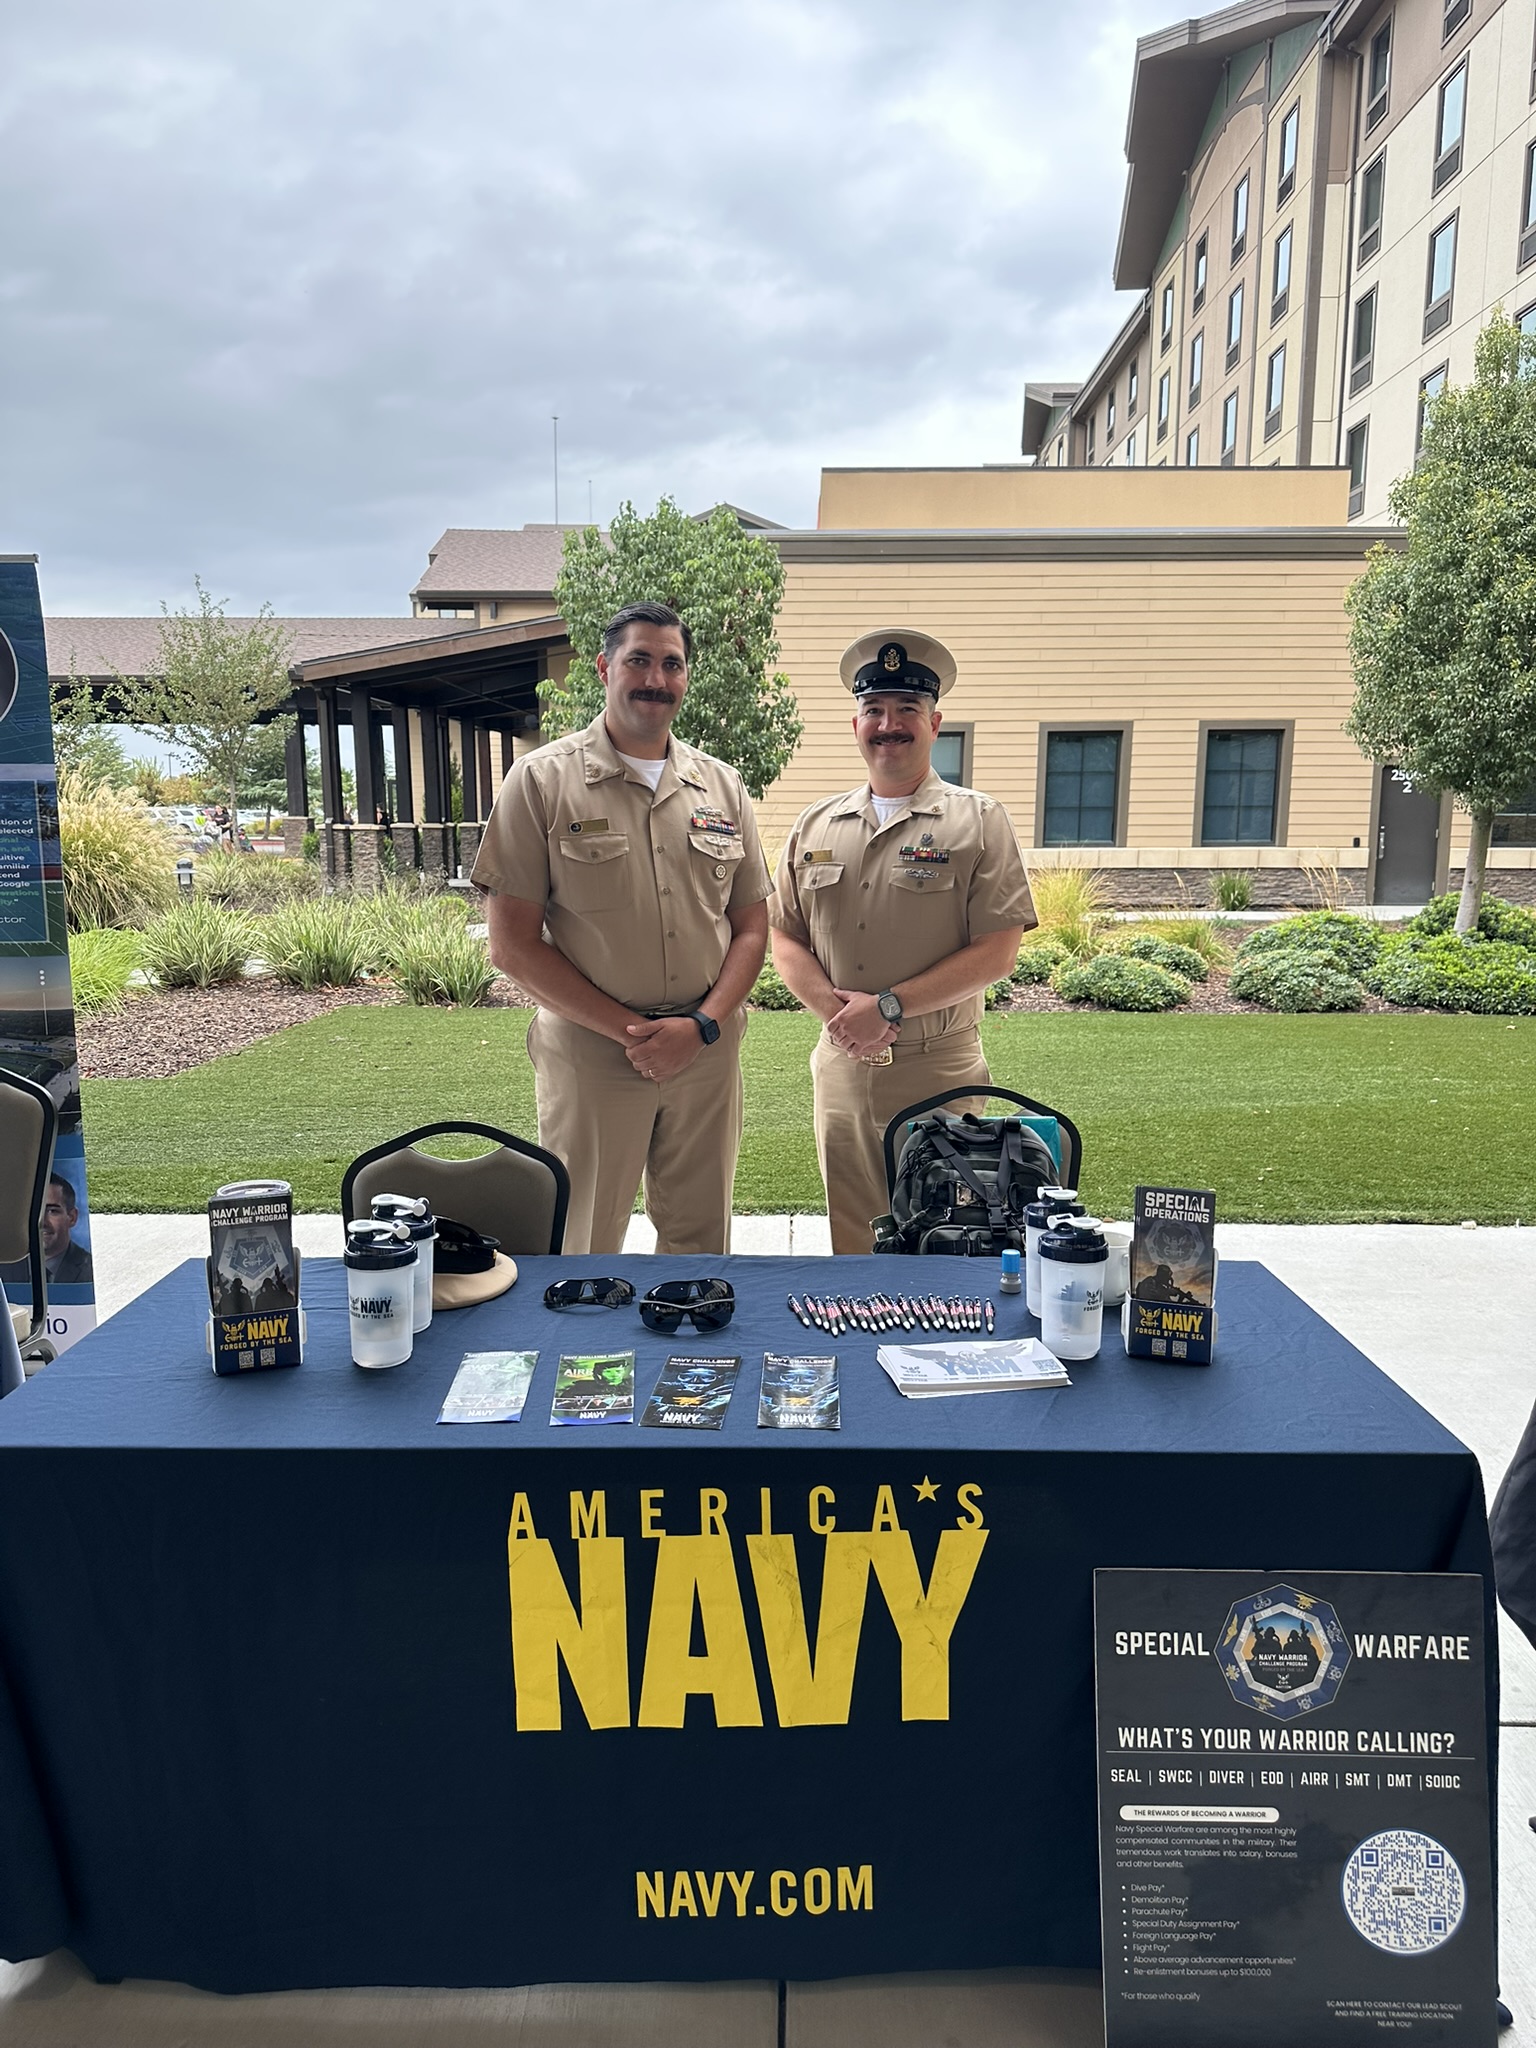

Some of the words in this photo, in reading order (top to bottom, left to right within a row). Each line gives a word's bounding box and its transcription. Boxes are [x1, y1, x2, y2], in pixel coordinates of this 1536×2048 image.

[1403, 782, 1412, 793] 2
[1145, 1192, 1210, 1212] SPECIAL
[212, 1207, 239, 1220] NAVY
[243, 1203, 287, 1216] WARRIOR
[1145, 1207, 1210, 1224] OPERATIONS
[213, 1217, 253, 1227] CHALLENGE
[256, 1214, 288, 1222] PROGRAM
[1162, 1312, 1202, 1333] NAVY
[248, 1318, 288, 1340] NAVY
[1135, 1327, 1160, 1335] FORGED
[579, 1411, 606, 1419] NAVY
[663, 1412, 701, 1422] NAVY
[780, 1414, 816, 1423] NAVY
[507, 1529, 990, 1731] NAVY
[1115, 1631, 1210, 1656] SPECIAL
[1354, 1634, 1470, 1660] WARFARE
[1118, 1727, 1193, 1749] WHAT'S
[1200, 1728, 1251, 1750] YOUR
[1259, 1729, 1350, 1752] WARRIOR
[1357, 1731, 1455, 1754] CALLING?
[1111, 1769, 1141, 1783] SEAL
[1158, 1770, 1193, 1784] SWCC
[1209, 1770, 1244, 1785] DIVER
[1261, 1771, 1284, 1785] EOD
[1300, 1772, 1329, 1786] AIRR
[1345, 1773, 1371, 1787] SMT
[1387, 1774, 1413, 1788] DMT
[1425, 1774, 1460, 1789] SOIDC
[1115, 1825, 1134, 1834] Navy
[1136, 1826, 1163, 1835] Special
[1210, 1827, 1238, 1836] among
[1275, 1826, 1296, 1836] highly
[1116, 1837, 1168, 1846] compensated
[1248, 1839, 1276, 1847] military.
[636, 1865, 874, 1918] NAVY.COM
[1132, 1920, 1159, 1928] Special
[1160, 1920, 1176, 1929] Duty
[1178, 1920, 1222, 1929] Assignment
[1133, 1932, 1160, 1940] Foreign
[1161, 1932, 1198, 1941] Language
[1133, 1944, 1152, 1953] Flight
[1219, 1970, 1230, 1978] up
[1176, 1993, 1200, 2001] qualify
